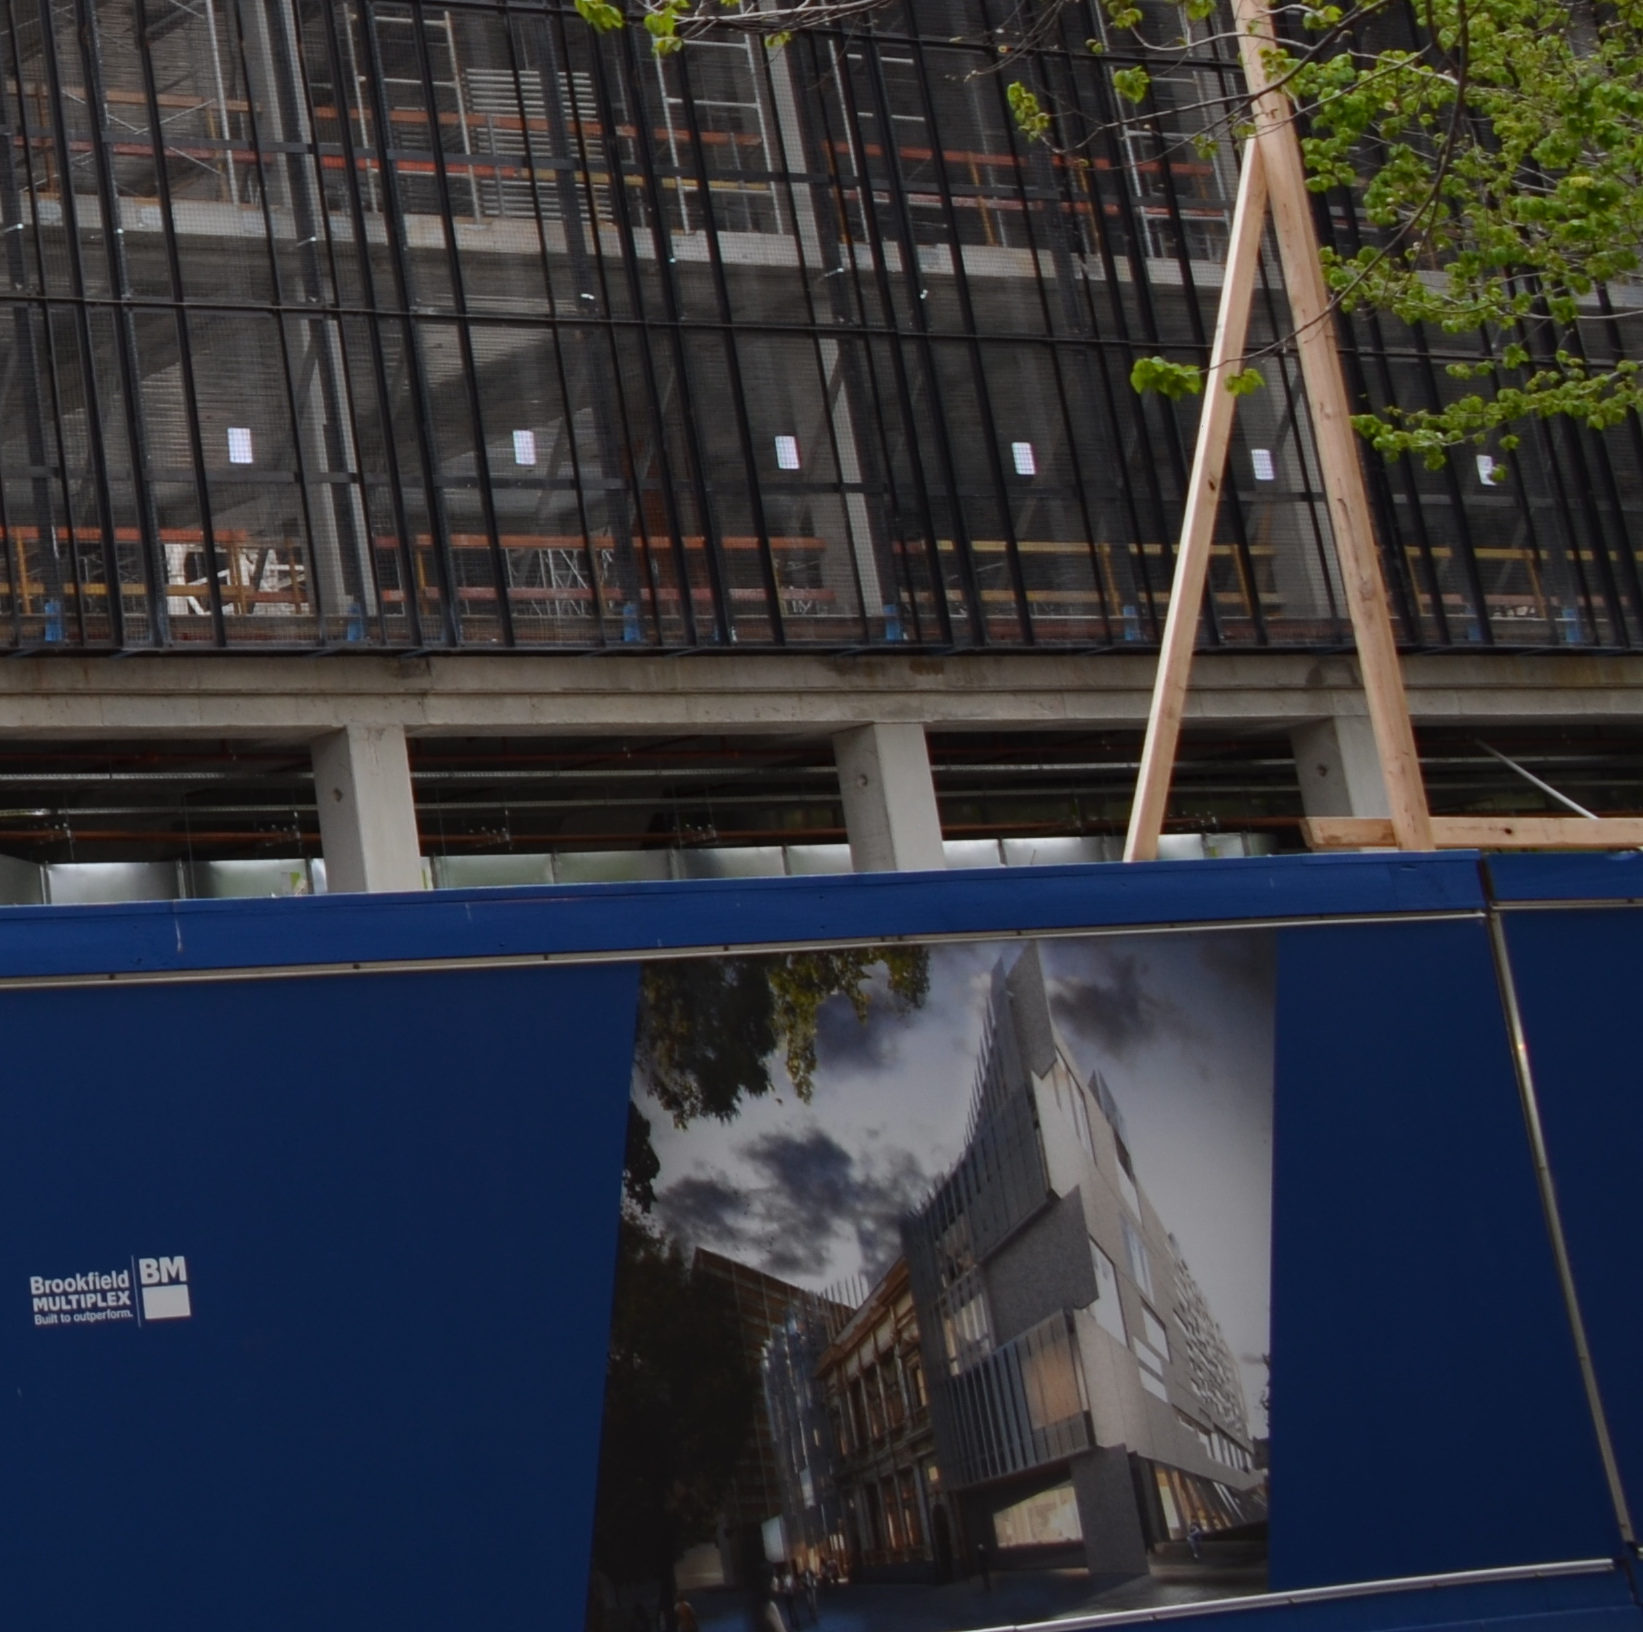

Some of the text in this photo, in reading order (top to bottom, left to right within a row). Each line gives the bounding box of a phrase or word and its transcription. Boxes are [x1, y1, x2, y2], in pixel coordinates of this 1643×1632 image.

[30, 1269, 130, 1295] Brookfield
[138, 1255, 188, 1285] BM
[32, 1290, 131, 1313] MULTIPLEX
[34, 1308, 134, 1326] Built to outperform.
